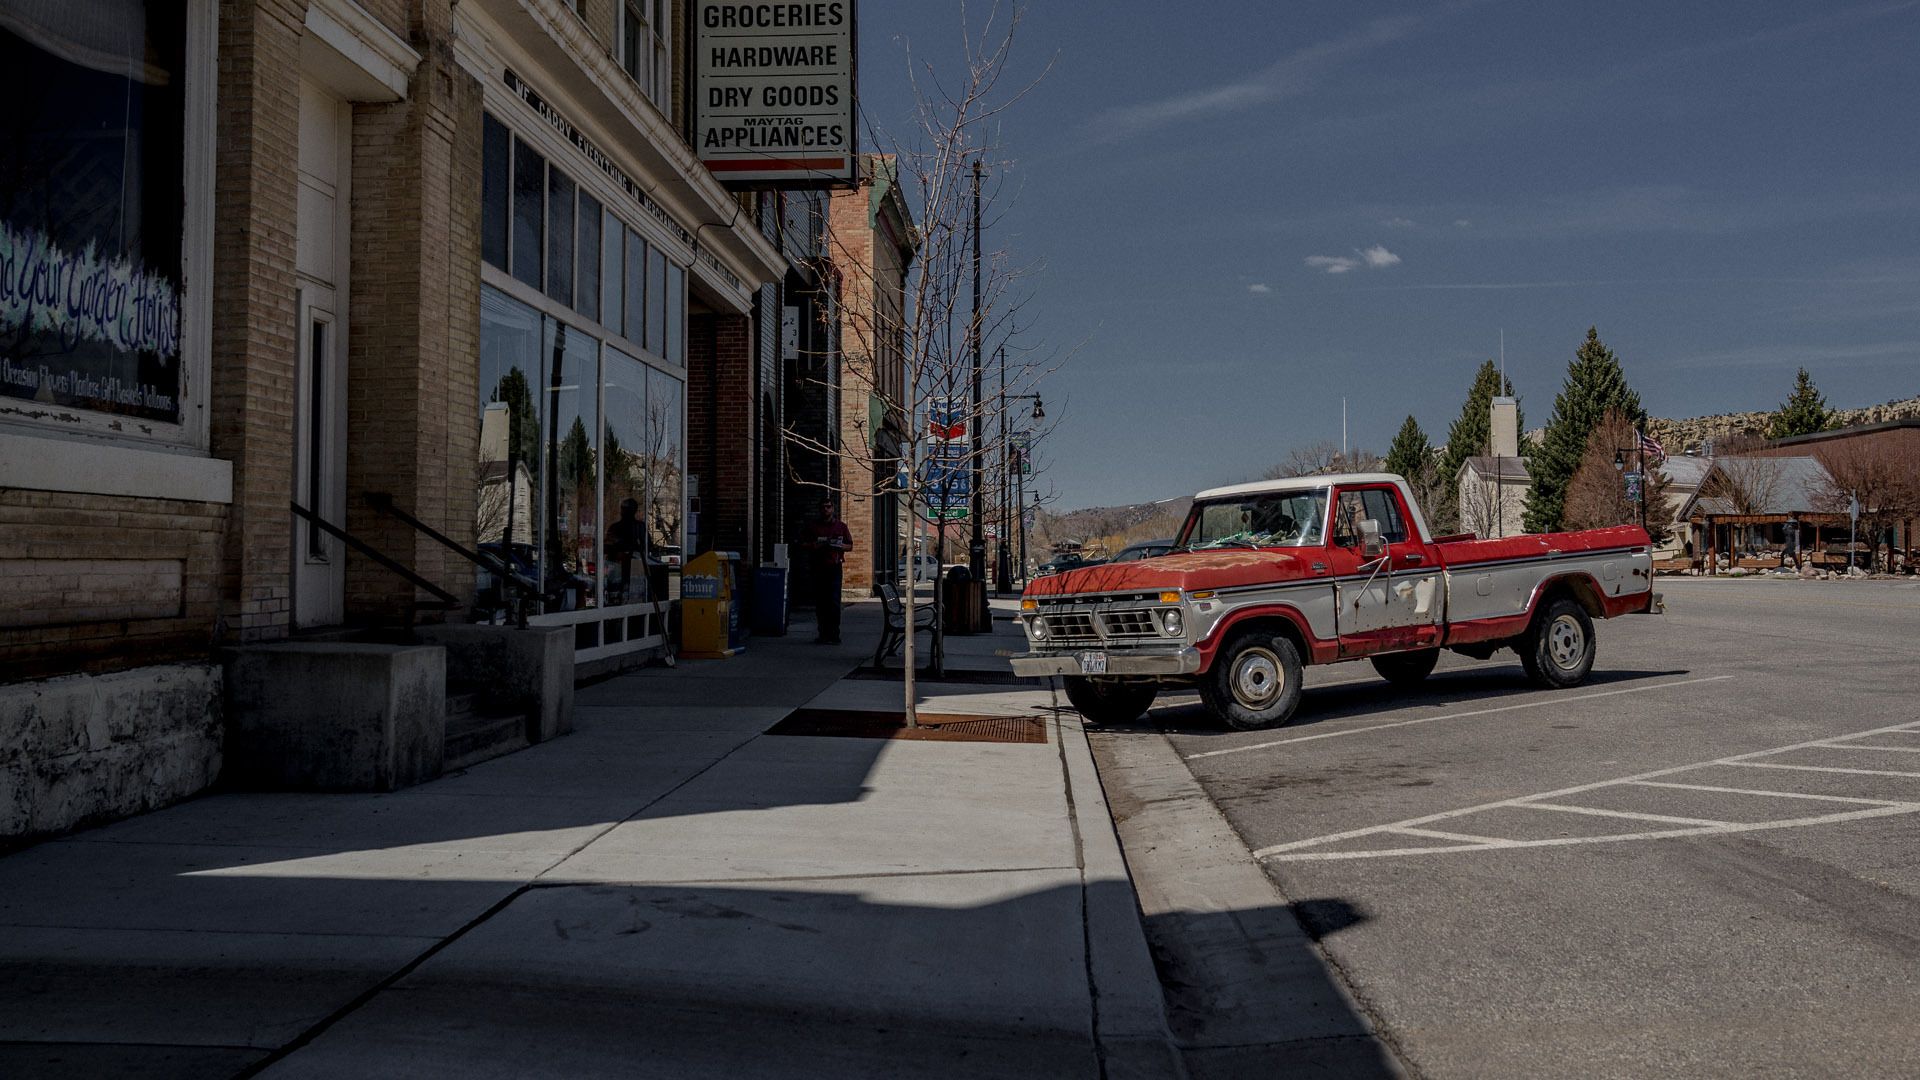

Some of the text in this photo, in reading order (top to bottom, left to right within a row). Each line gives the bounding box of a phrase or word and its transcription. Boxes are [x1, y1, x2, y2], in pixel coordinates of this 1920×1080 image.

[704, 2, 843, 28] GROCERIES
[711, 45, 837, 68] HARDWARE
[709, 85, 839, 108] DRY GOODS
[743, 117, 804, 126] MAYTAG
[515, 79, 530, 101] WE
[539, 101, 571, 140] CARRY
[578, 135, 627, 190] EVERYTHING
[631, 183, 639, 201] IN
[704, 126, 843, 148] APPLIANCES
[17, 226, 68, 346] Your
[61, 248, 127, 353] Garden
[128, 267, 178, 354] Florist
